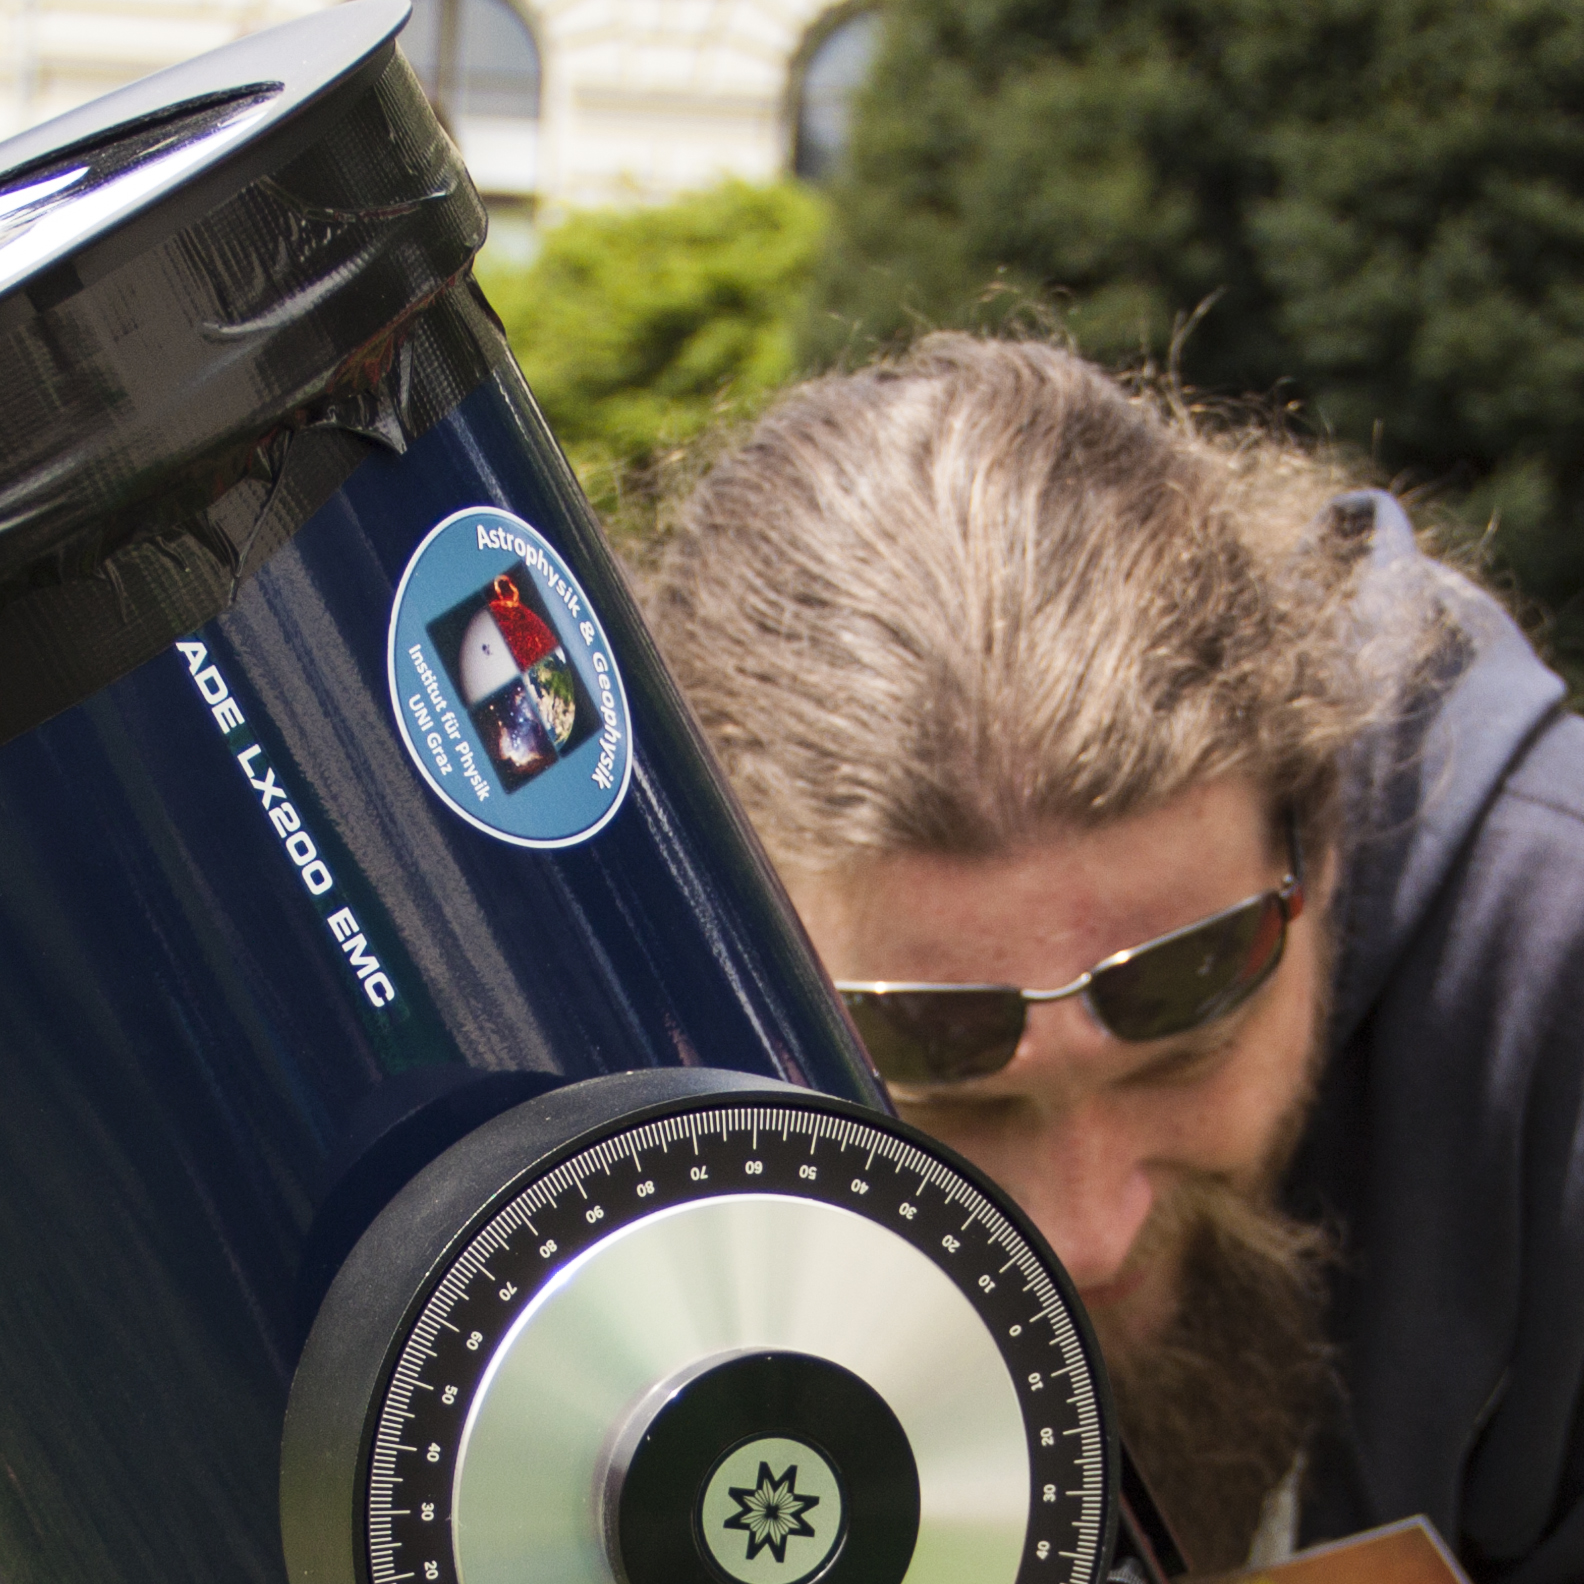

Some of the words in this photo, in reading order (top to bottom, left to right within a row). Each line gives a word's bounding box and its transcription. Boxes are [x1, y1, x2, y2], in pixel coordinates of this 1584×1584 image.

[476, 524, 581, 619] Astrophysik
[579, 620, 596, 647] &
[591, 651, 622, 790] Geophysik
[408, 643, 448, 713] Institut
[440, 710, 462, 740] für
[454, 740, 491, 802] Physik
[408, 693, 435, 732] UNI
[426, 731, 453, 776] Graz
[175, 641, 246, 735] ADE
[237, 743, 334, 896] LX200
[326, 906, 396, 1009] EMC
[690, 1165, 709, 1181] 70
[744, 1160, 764, 1175] 60
[798, 1164, 818, 1181] 50
[636, 1180, 656, 1198] 80
[850, 1178, 870, 1195] 40
[585, 1205, 605, 1224] 90
[898, 1202, 918, 1220] 30
[539, 1239, 558, 1259] 80
[941, 1234, 961, 1254] 20
[498, 1281, 518, 1302] 70
[978, 1274, 996, 1294] 10
[465, 1330, 484, 1351] 60
[1008, 1324, 1022, 1337] 0
[1027, 1372, 1044, 1392] 10
[441, 1384, 459, 1405] 50
[1039, 1427, 1055, 1447] 20
[426, 1442, 441, 1463] 40
[1042, 1483, 1057, 1503] 30
[420, 1502, 435, 1522] 30
[1036, 1540, 1051, 1560] 40
[423, 1560, 439, 1580] 20
